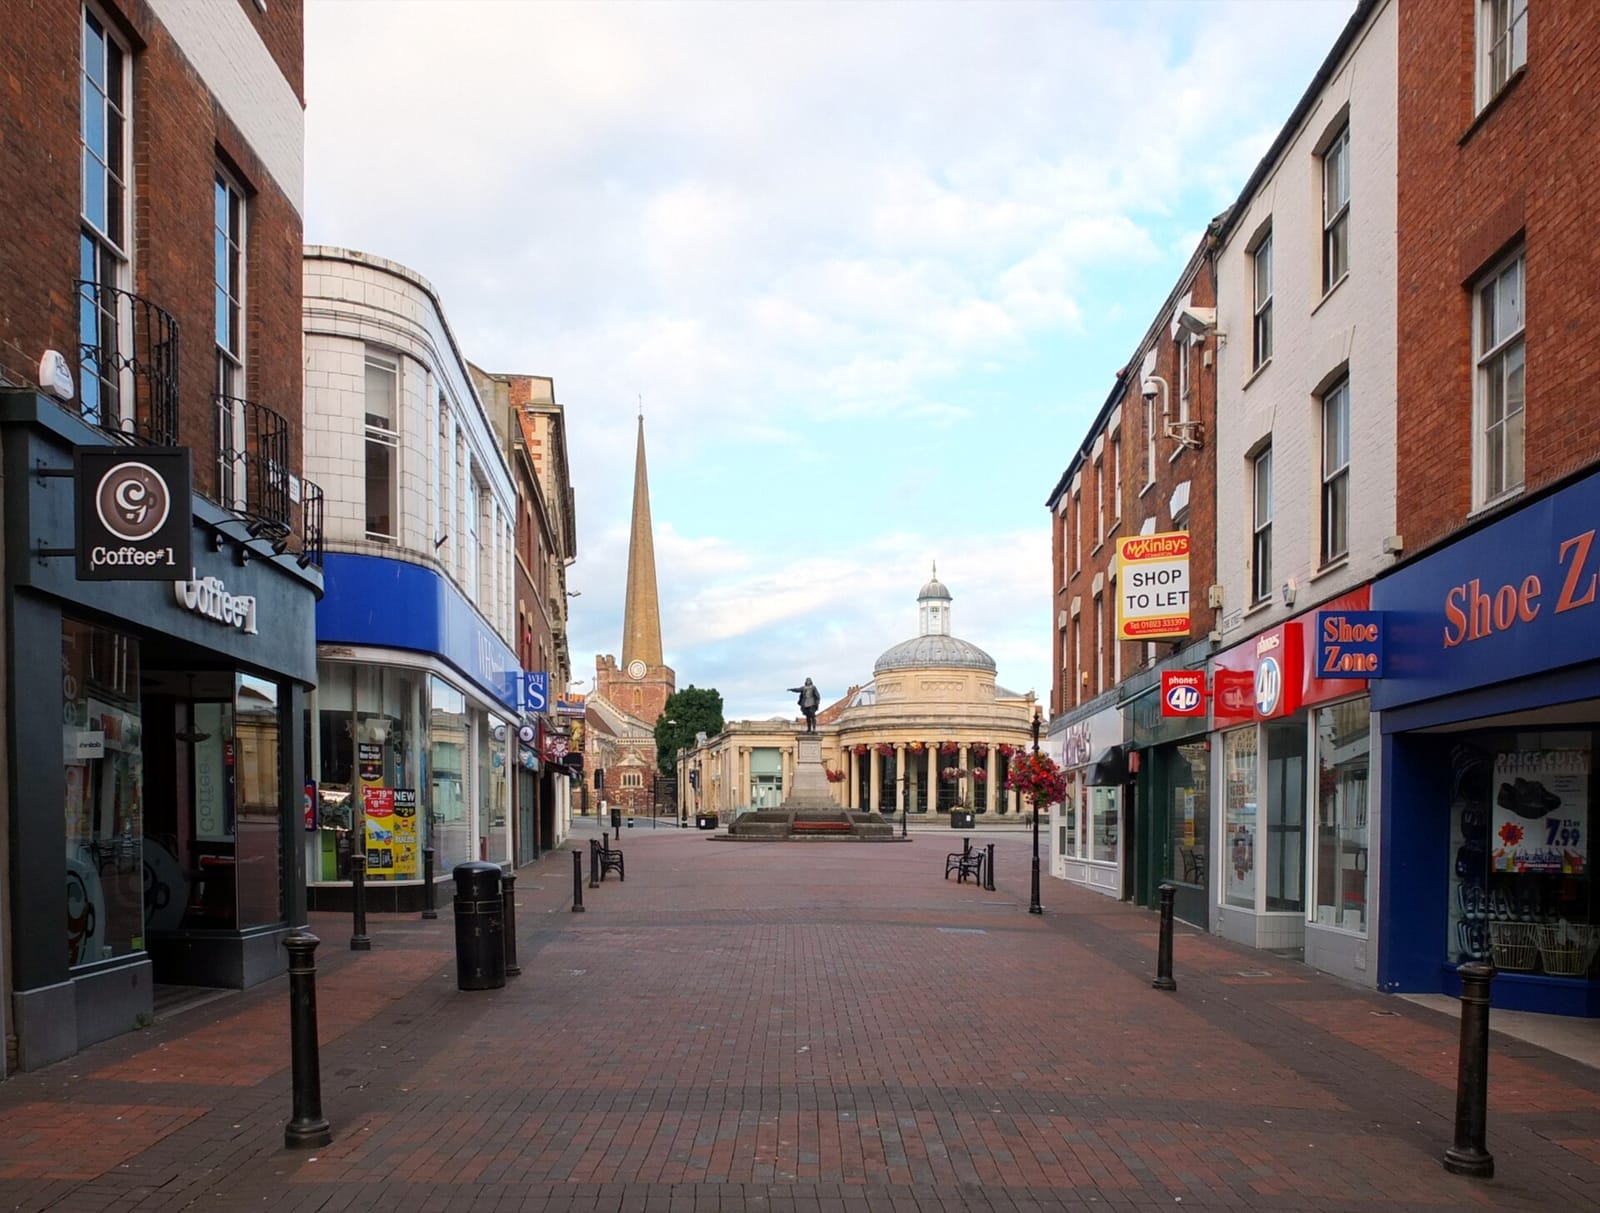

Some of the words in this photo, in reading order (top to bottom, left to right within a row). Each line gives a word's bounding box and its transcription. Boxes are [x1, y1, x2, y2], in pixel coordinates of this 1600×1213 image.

[92, 546, 176, 566] Coffee#1
[1126, 538, 1188, 558] McKinlays
[1133, 569, 1182, 587] SHOP
[1443, 575, 1542, 649] Shoe
[1555, 529, 1600, 614] Z
[1126, 594, 1150, 609] TO
[1156, 590, 1189, 607] LET
[1324, 616, 1379, 643] Shoe
[1324, 645, 1379, 672] Zone
[528, 674, 544, 683] WH
[1168, 675, 1198, 686] phones
[528, 682, 545, 710] S
[1170, 687, 1198, 709] 4u
[1497, 751, 1541, 767] PRICE
[1547, 750, 1585, 765] CUTS
[393, 790, 415, 801] NEW
[1546, 818, 1581, 847] 7.99
